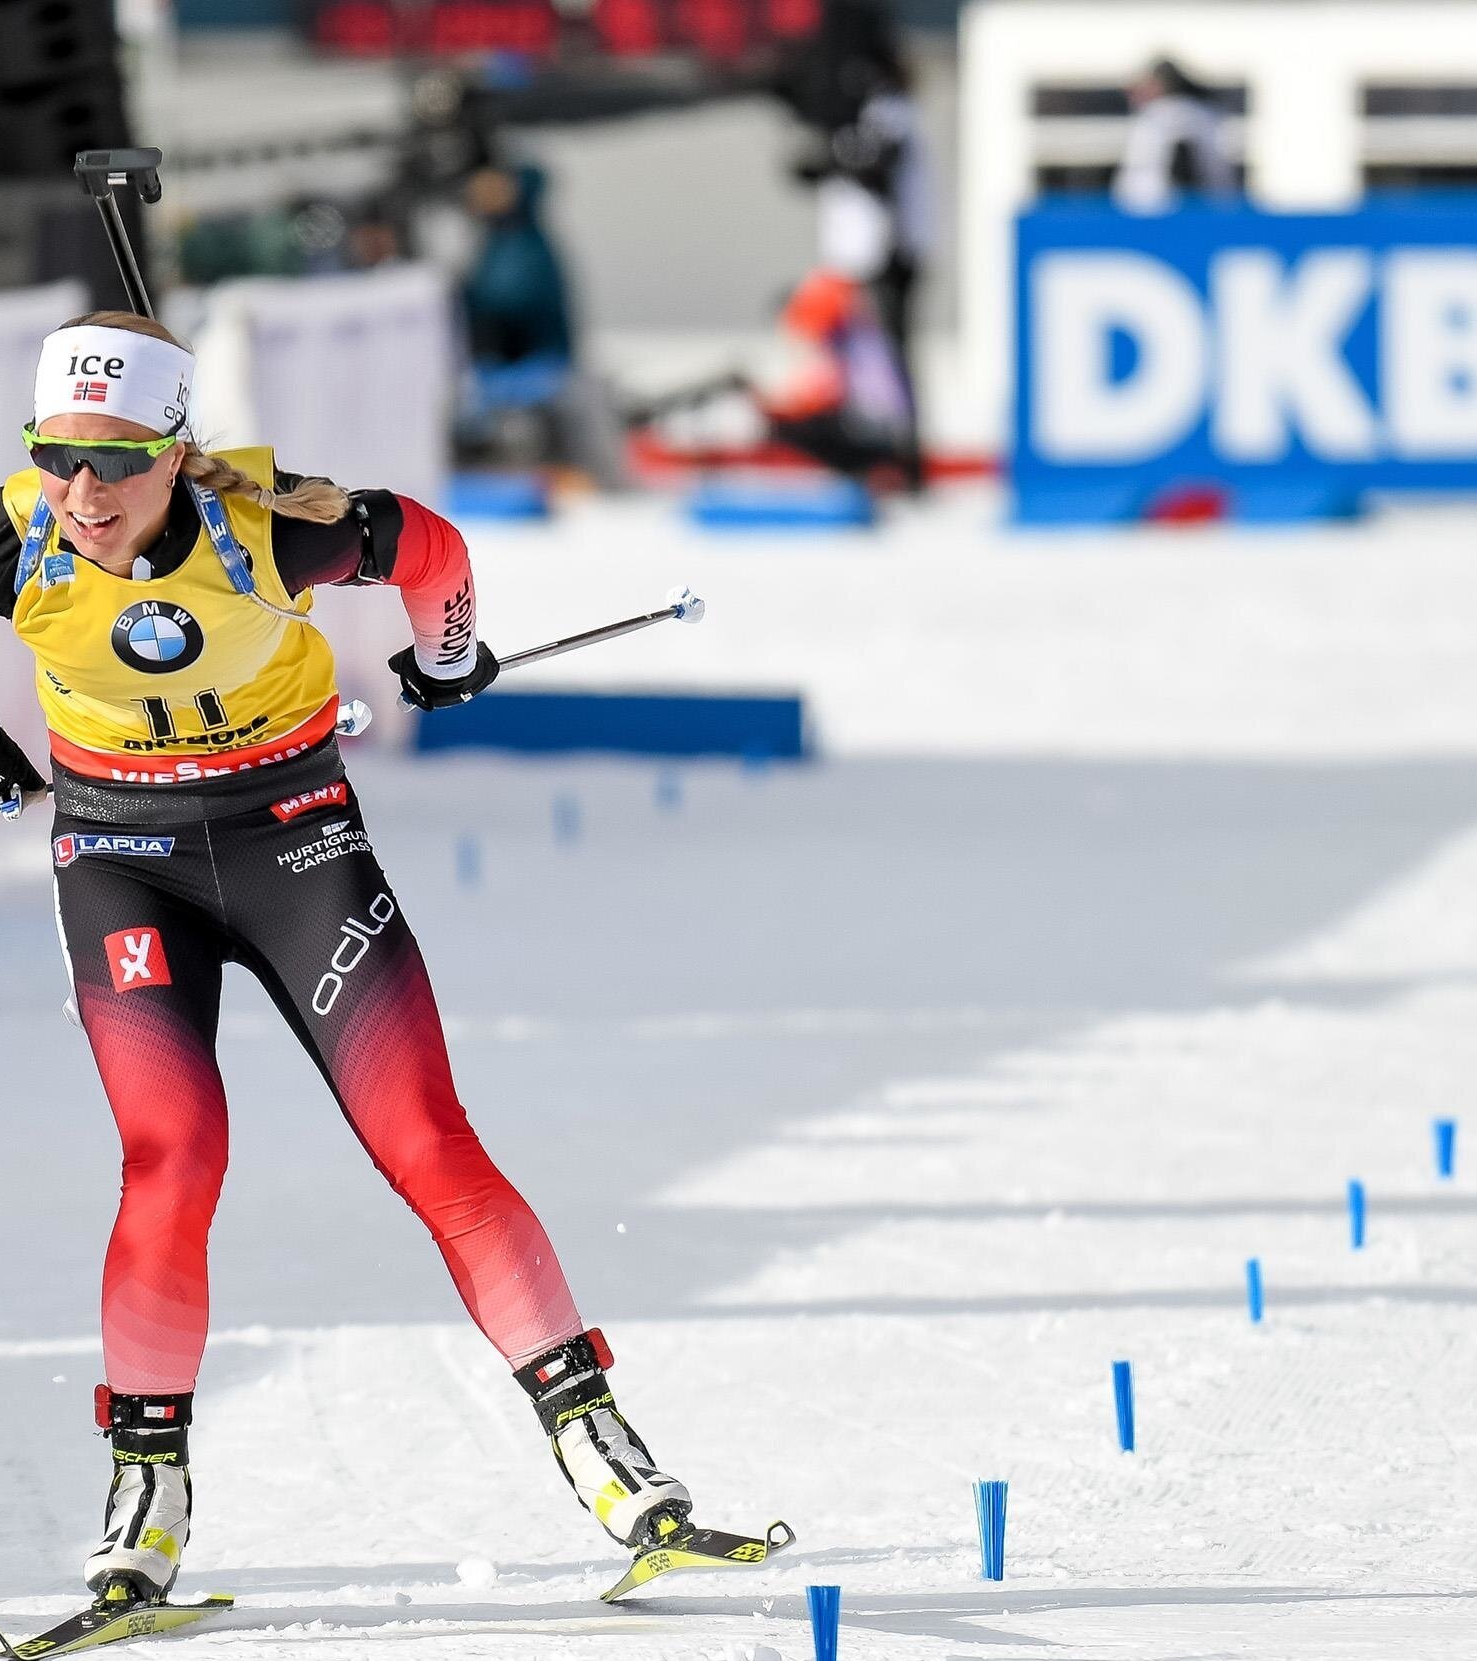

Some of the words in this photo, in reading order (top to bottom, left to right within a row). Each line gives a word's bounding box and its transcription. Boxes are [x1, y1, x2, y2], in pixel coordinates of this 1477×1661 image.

[67, 350, 124, 379] ice
[1027, 247, 1477, 470] DKB
[116, 601, 192, 632] BMW
[436, 577, 472, 665] NORGE
[280, 787, 340, 814] MENY
[79, 837, 165, 853] LAPUA
[311, 892, 395, 1016] odlo
